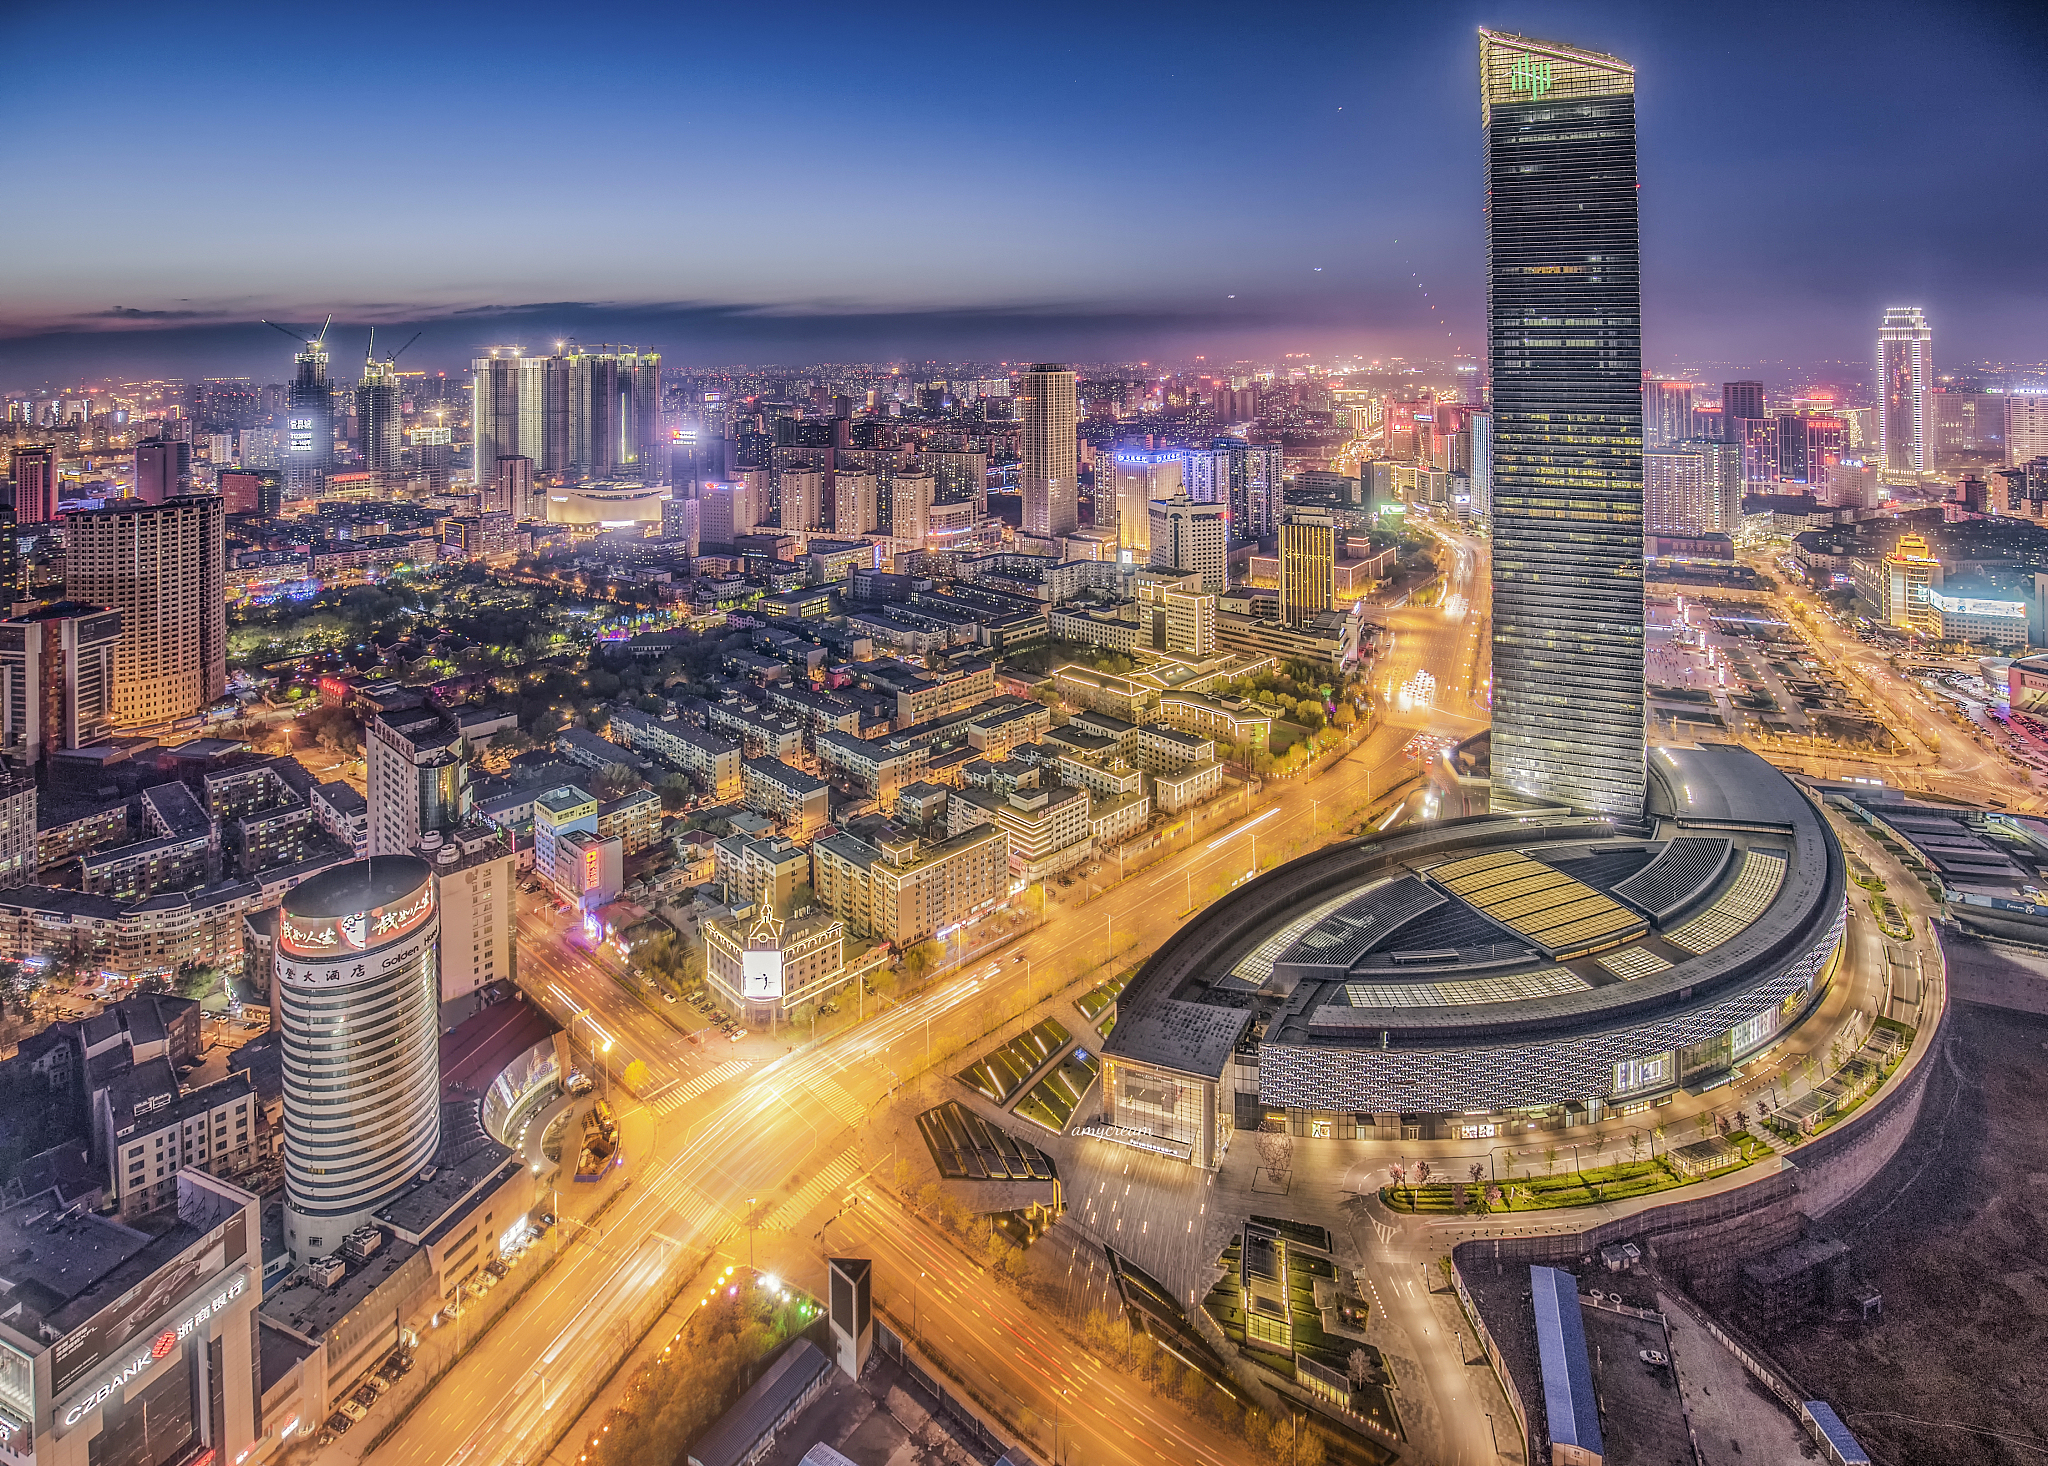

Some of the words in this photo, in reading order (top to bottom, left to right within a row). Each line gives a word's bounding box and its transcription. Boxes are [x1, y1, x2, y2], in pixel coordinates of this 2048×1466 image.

[382, 945, 419, 968] Golden
[177, 1278, 245, 1341] 浙商银行
[64, 1350, 152, 1426] CZBANK
